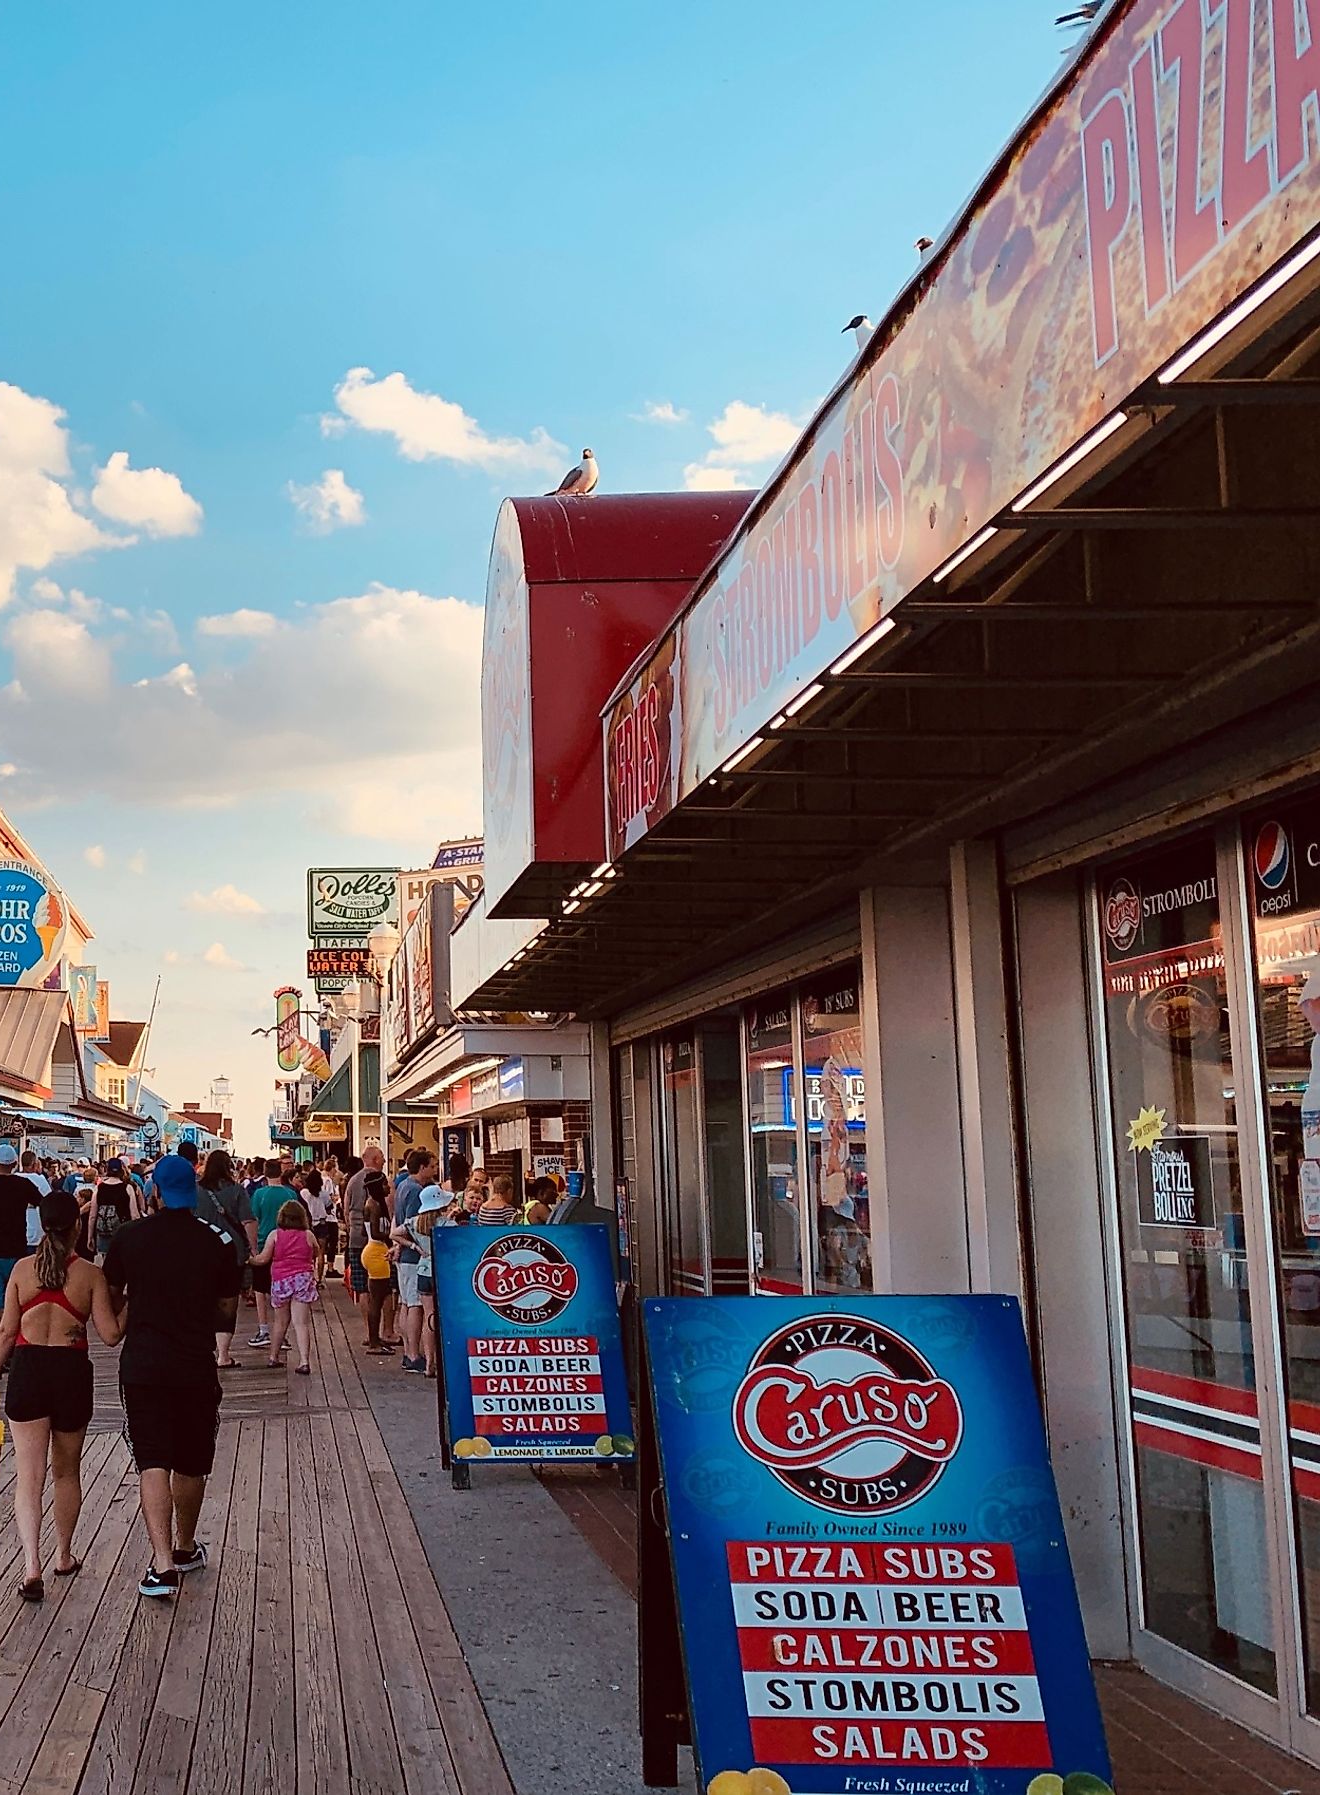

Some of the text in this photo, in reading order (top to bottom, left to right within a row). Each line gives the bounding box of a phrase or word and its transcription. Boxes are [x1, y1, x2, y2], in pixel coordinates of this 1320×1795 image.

[712, 372, 905, 738] STROMBOLIS
[615, 682, 660, 834] FRIES
[5, 884, 27, 892] 1919
[1143, 877, 1217, 918] STROMBOLI
[1260, 890, 1292, 916] pepsi
[329, 903, 385, 918] SALT WATER TAFFY
[323, 938, 364, 948] TAFFY
[313, 951, 337, 962] ICE
[309, 961, 358, 972] WATER
[537, 1156, 566, 1168] SHAVE
[544, 1165, 561, 1176] ICE
[1151, 1162, 1195, 1192] PRETZEL
[501, 1239, 542, 1252] PIZZA
[480, 1263, 570, 1300] Caruso
[512, 1308, 548, 1321] SUBS
[476, 1338, 590, 1355] PIZZA SUBS
[792, 1324, 878, 1356] PIZZA
[479, 1358, 591, 1373] SODA BEER
[485, 1377, 588, 1394] CALZONES
[483, 1396, 596, 1412] STOMBOLIS
[501, 1416, 581, 1432] SALADS
[744, 1376, 947, 1458] Caruso
[515, 1438, 571, 1447] Fresh Squeezed
[493, 1448, 544, 1457] LEMONADE
[555, 1448, 594, 1456] LIMEADE
[819, 1478, 900, 1505] SUBS
[765, 1520, 968, 1538] Family Owned Since 1989
[747, 1547, 996, 1579] PIZZA SUBS
[754, 1590, 1005, 1623] SODA BEER
[775, 1634, 998, 1668] CALZONES
[767, 1679, 1022, 1714] STOMBOLIS
[812, 1725, 989, 1761] SALADS
[845, 1777, 969, 1794] Fresh Squeezed
